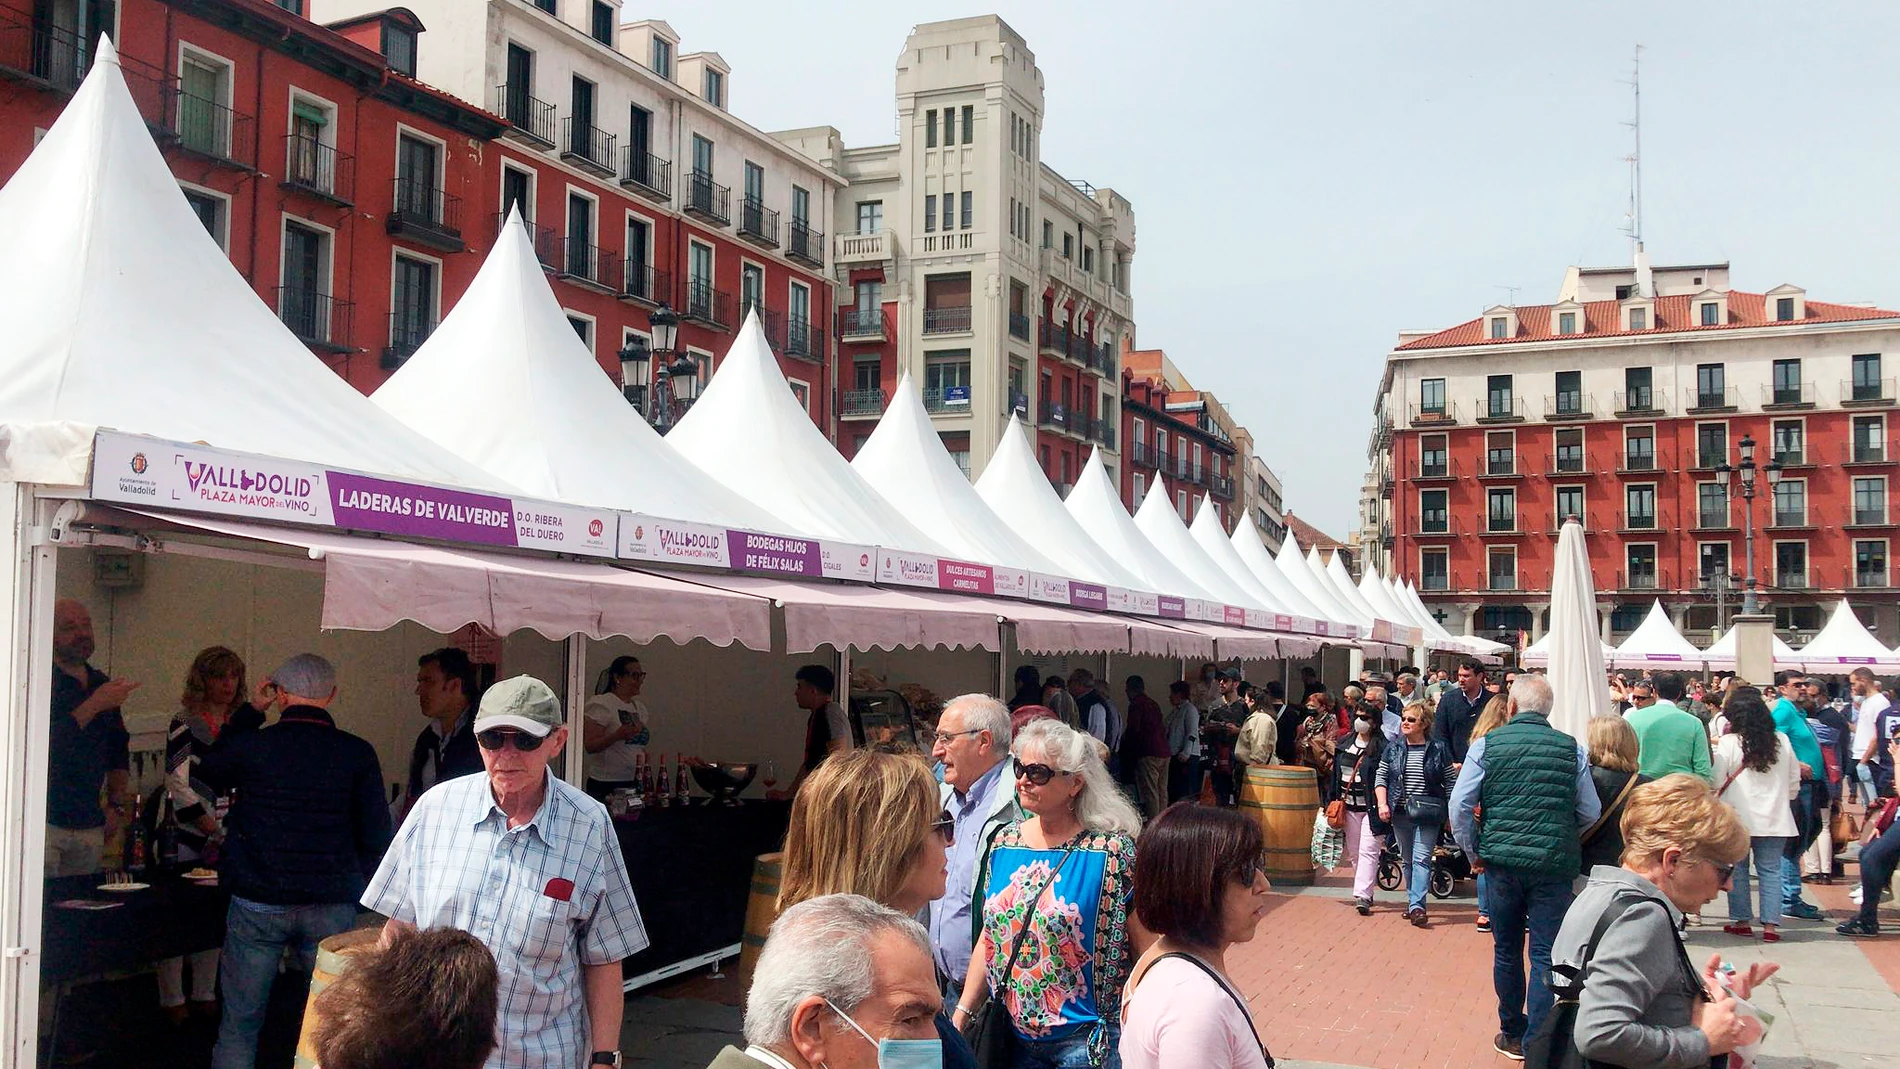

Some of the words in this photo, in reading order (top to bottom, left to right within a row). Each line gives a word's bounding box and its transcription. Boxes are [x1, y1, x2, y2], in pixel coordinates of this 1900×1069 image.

[119, 482, 156, 495] Valladolid
[201, 488, 236, 503] PLAZA
[239, 492, 275, 508] MAYOR
[285, 499, 309, 512] VINO
[339, 488, 412, 516] LADERAS
[412, 499, 434, 518] DE
[437, 502, 509, 528] VALVERDE
[517, 511, 533, 523] D.O.
[535, 513, 563, 527] RIBERA
[520, 526, 535, 538] DEL
[538, 528, 564, 542] DUERO
[667, 546, 684, 556] PLAZA
[684, 548, 702, 558] MAYOR
[747, 534, 784, 552] BODEGAS
[785, 539, 807, 554] HIJOS
[746, 554, 758, 567] DE
[758, 555, 780, 570] FÉLIX
[780, 558, 804, 573] SALAS
[823, 562, 842, 571] CIGALES
[946, 564, 963, 575] DULCES
